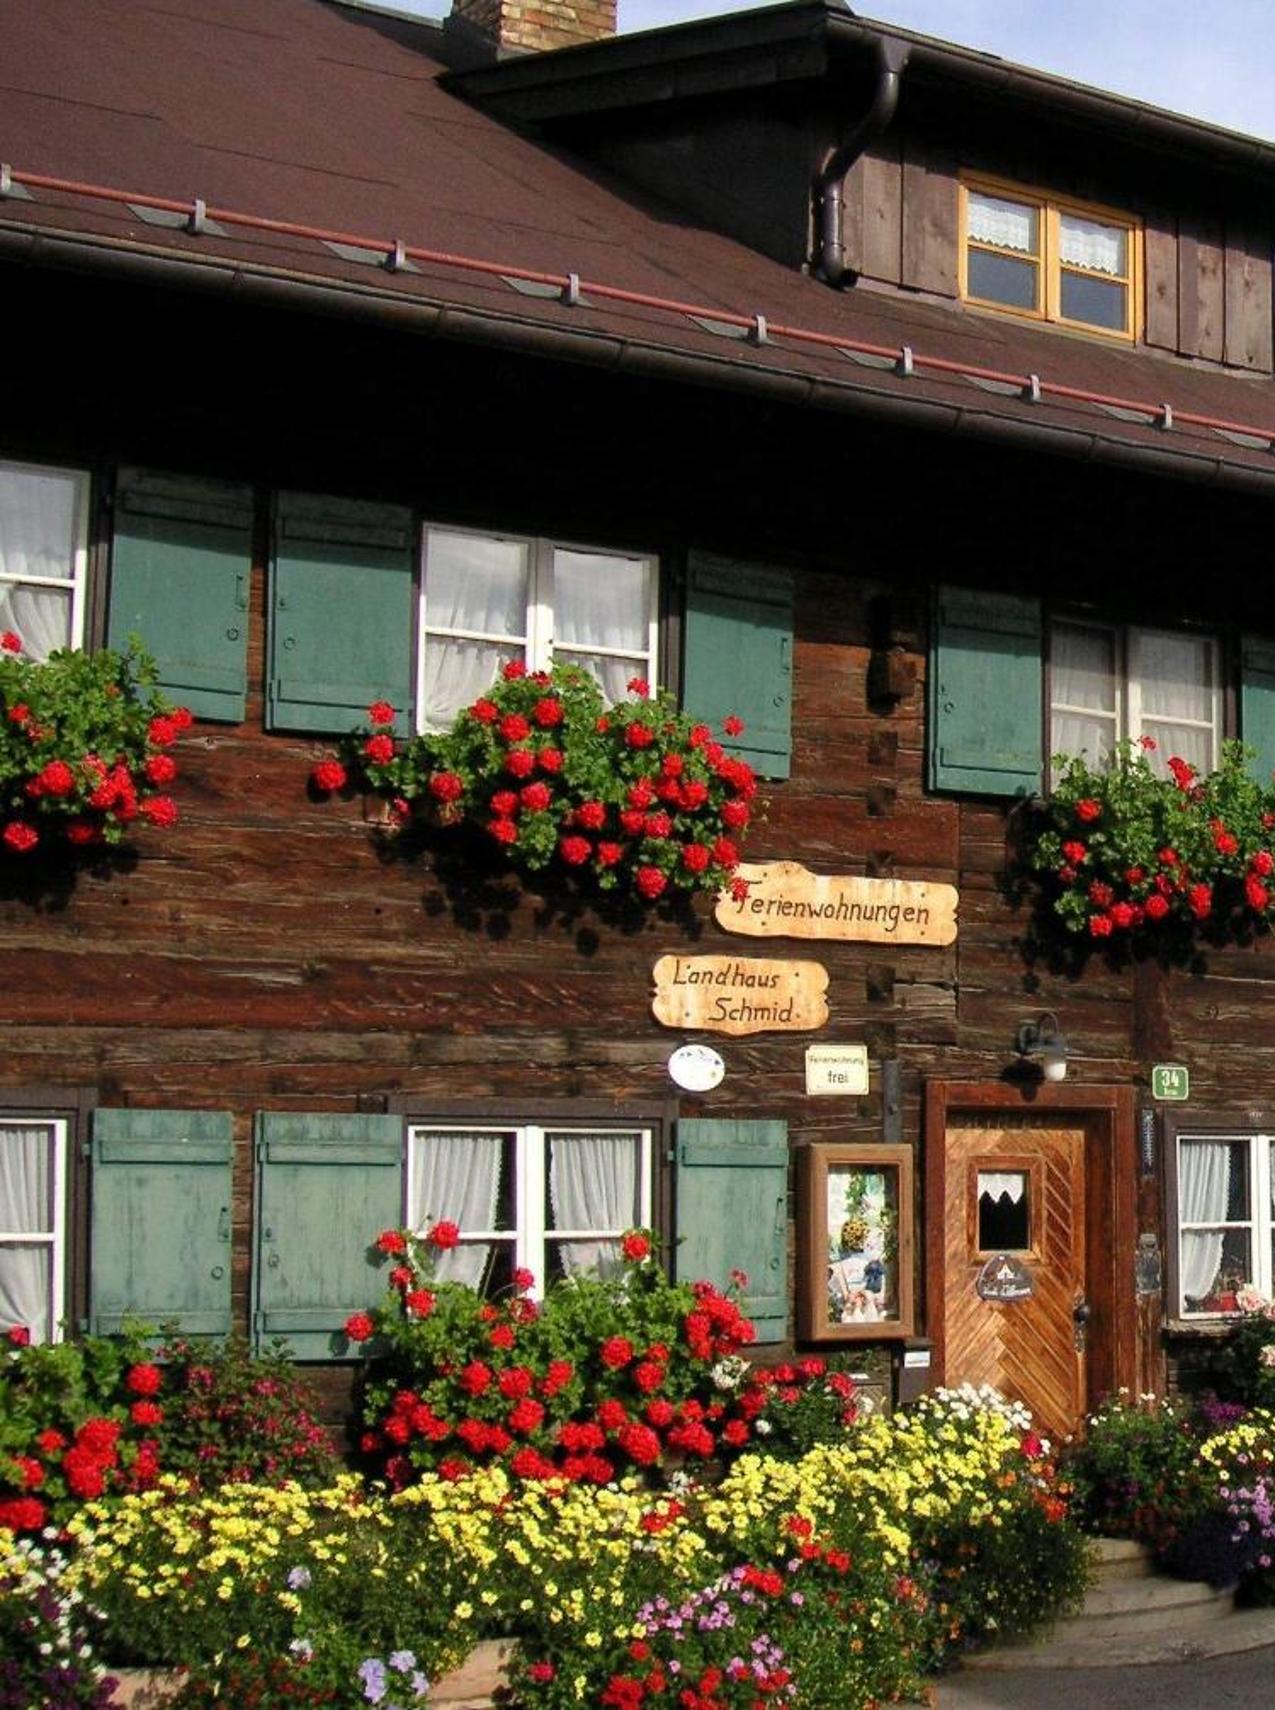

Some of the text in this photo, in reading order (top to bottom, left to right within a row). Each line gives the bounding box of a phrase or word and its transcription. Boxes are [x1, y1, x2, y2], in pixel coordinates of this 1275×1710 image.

[672, 959, 781, 989] Landhaus
[707, 997, 794, 1023] Schmid
[827, 1070, 849, 1084] frei
[1161, 1070, 1179, 1087] 34
